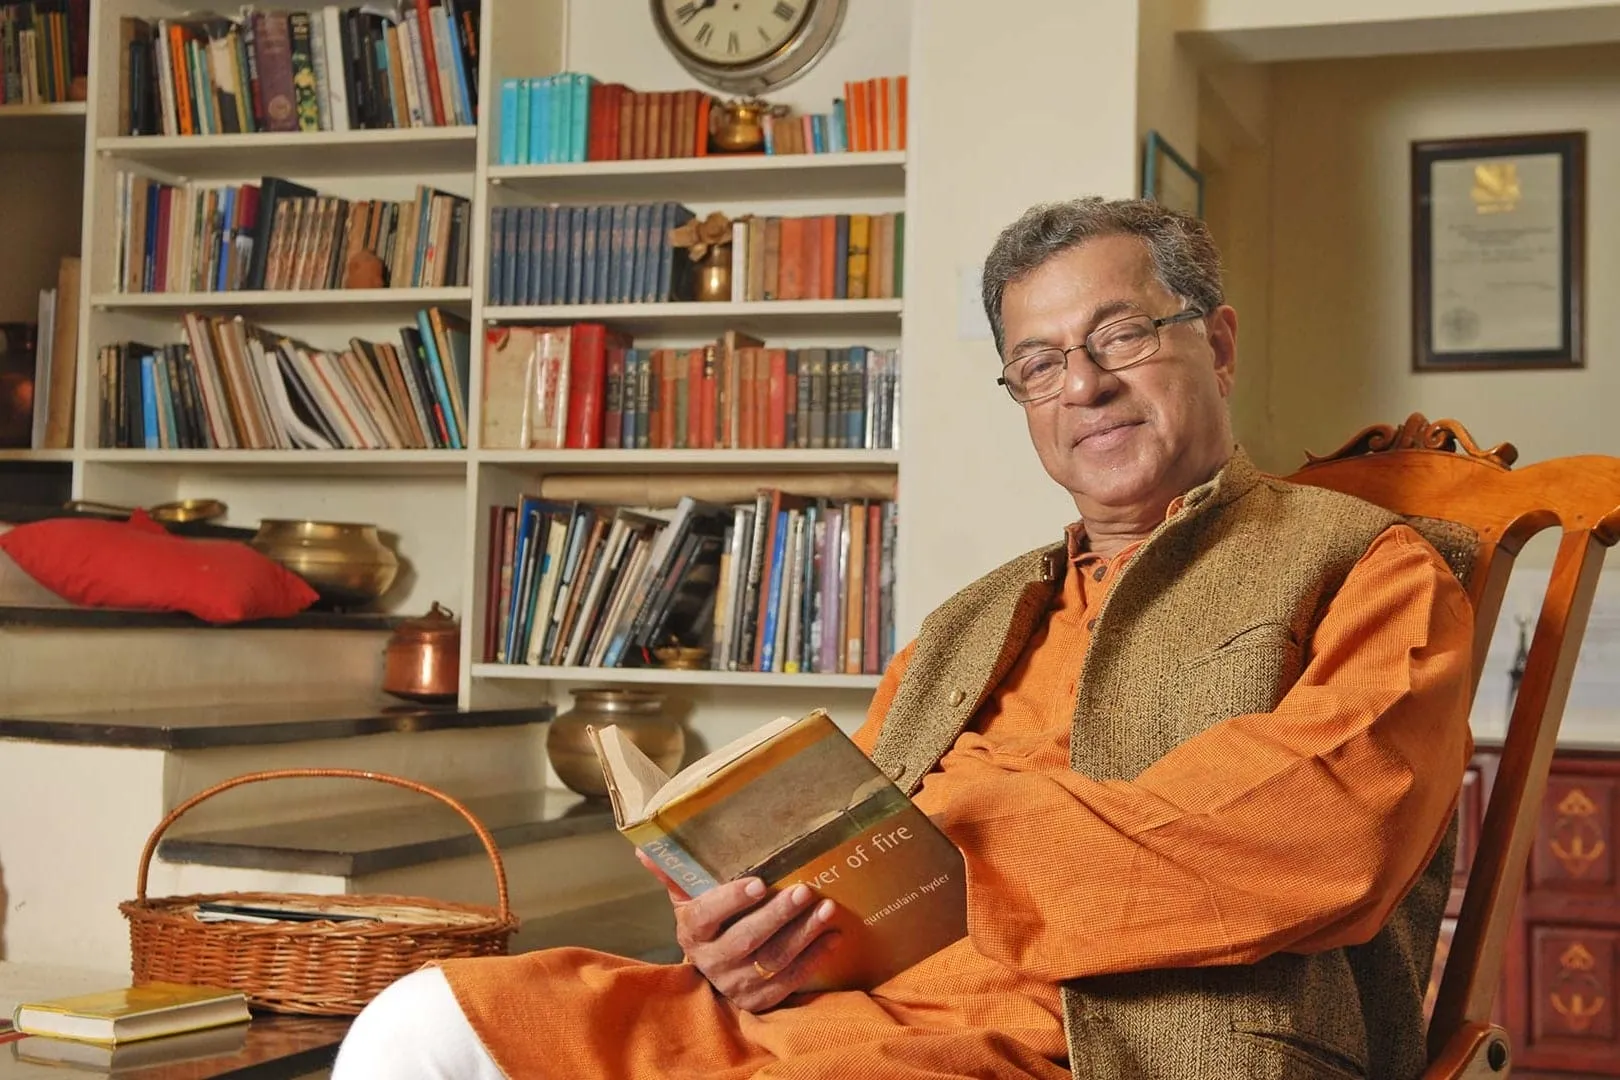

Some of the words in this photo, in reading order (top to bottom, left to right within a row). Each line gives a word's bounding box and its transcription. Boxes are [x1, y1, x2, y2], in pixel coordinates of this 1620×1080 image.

[846, 845, 871, 870] of
[872, 823, 914, 855] fire
[863, 892, 920, 926] qurratulain
[919, 873, 950, 894] hyder
